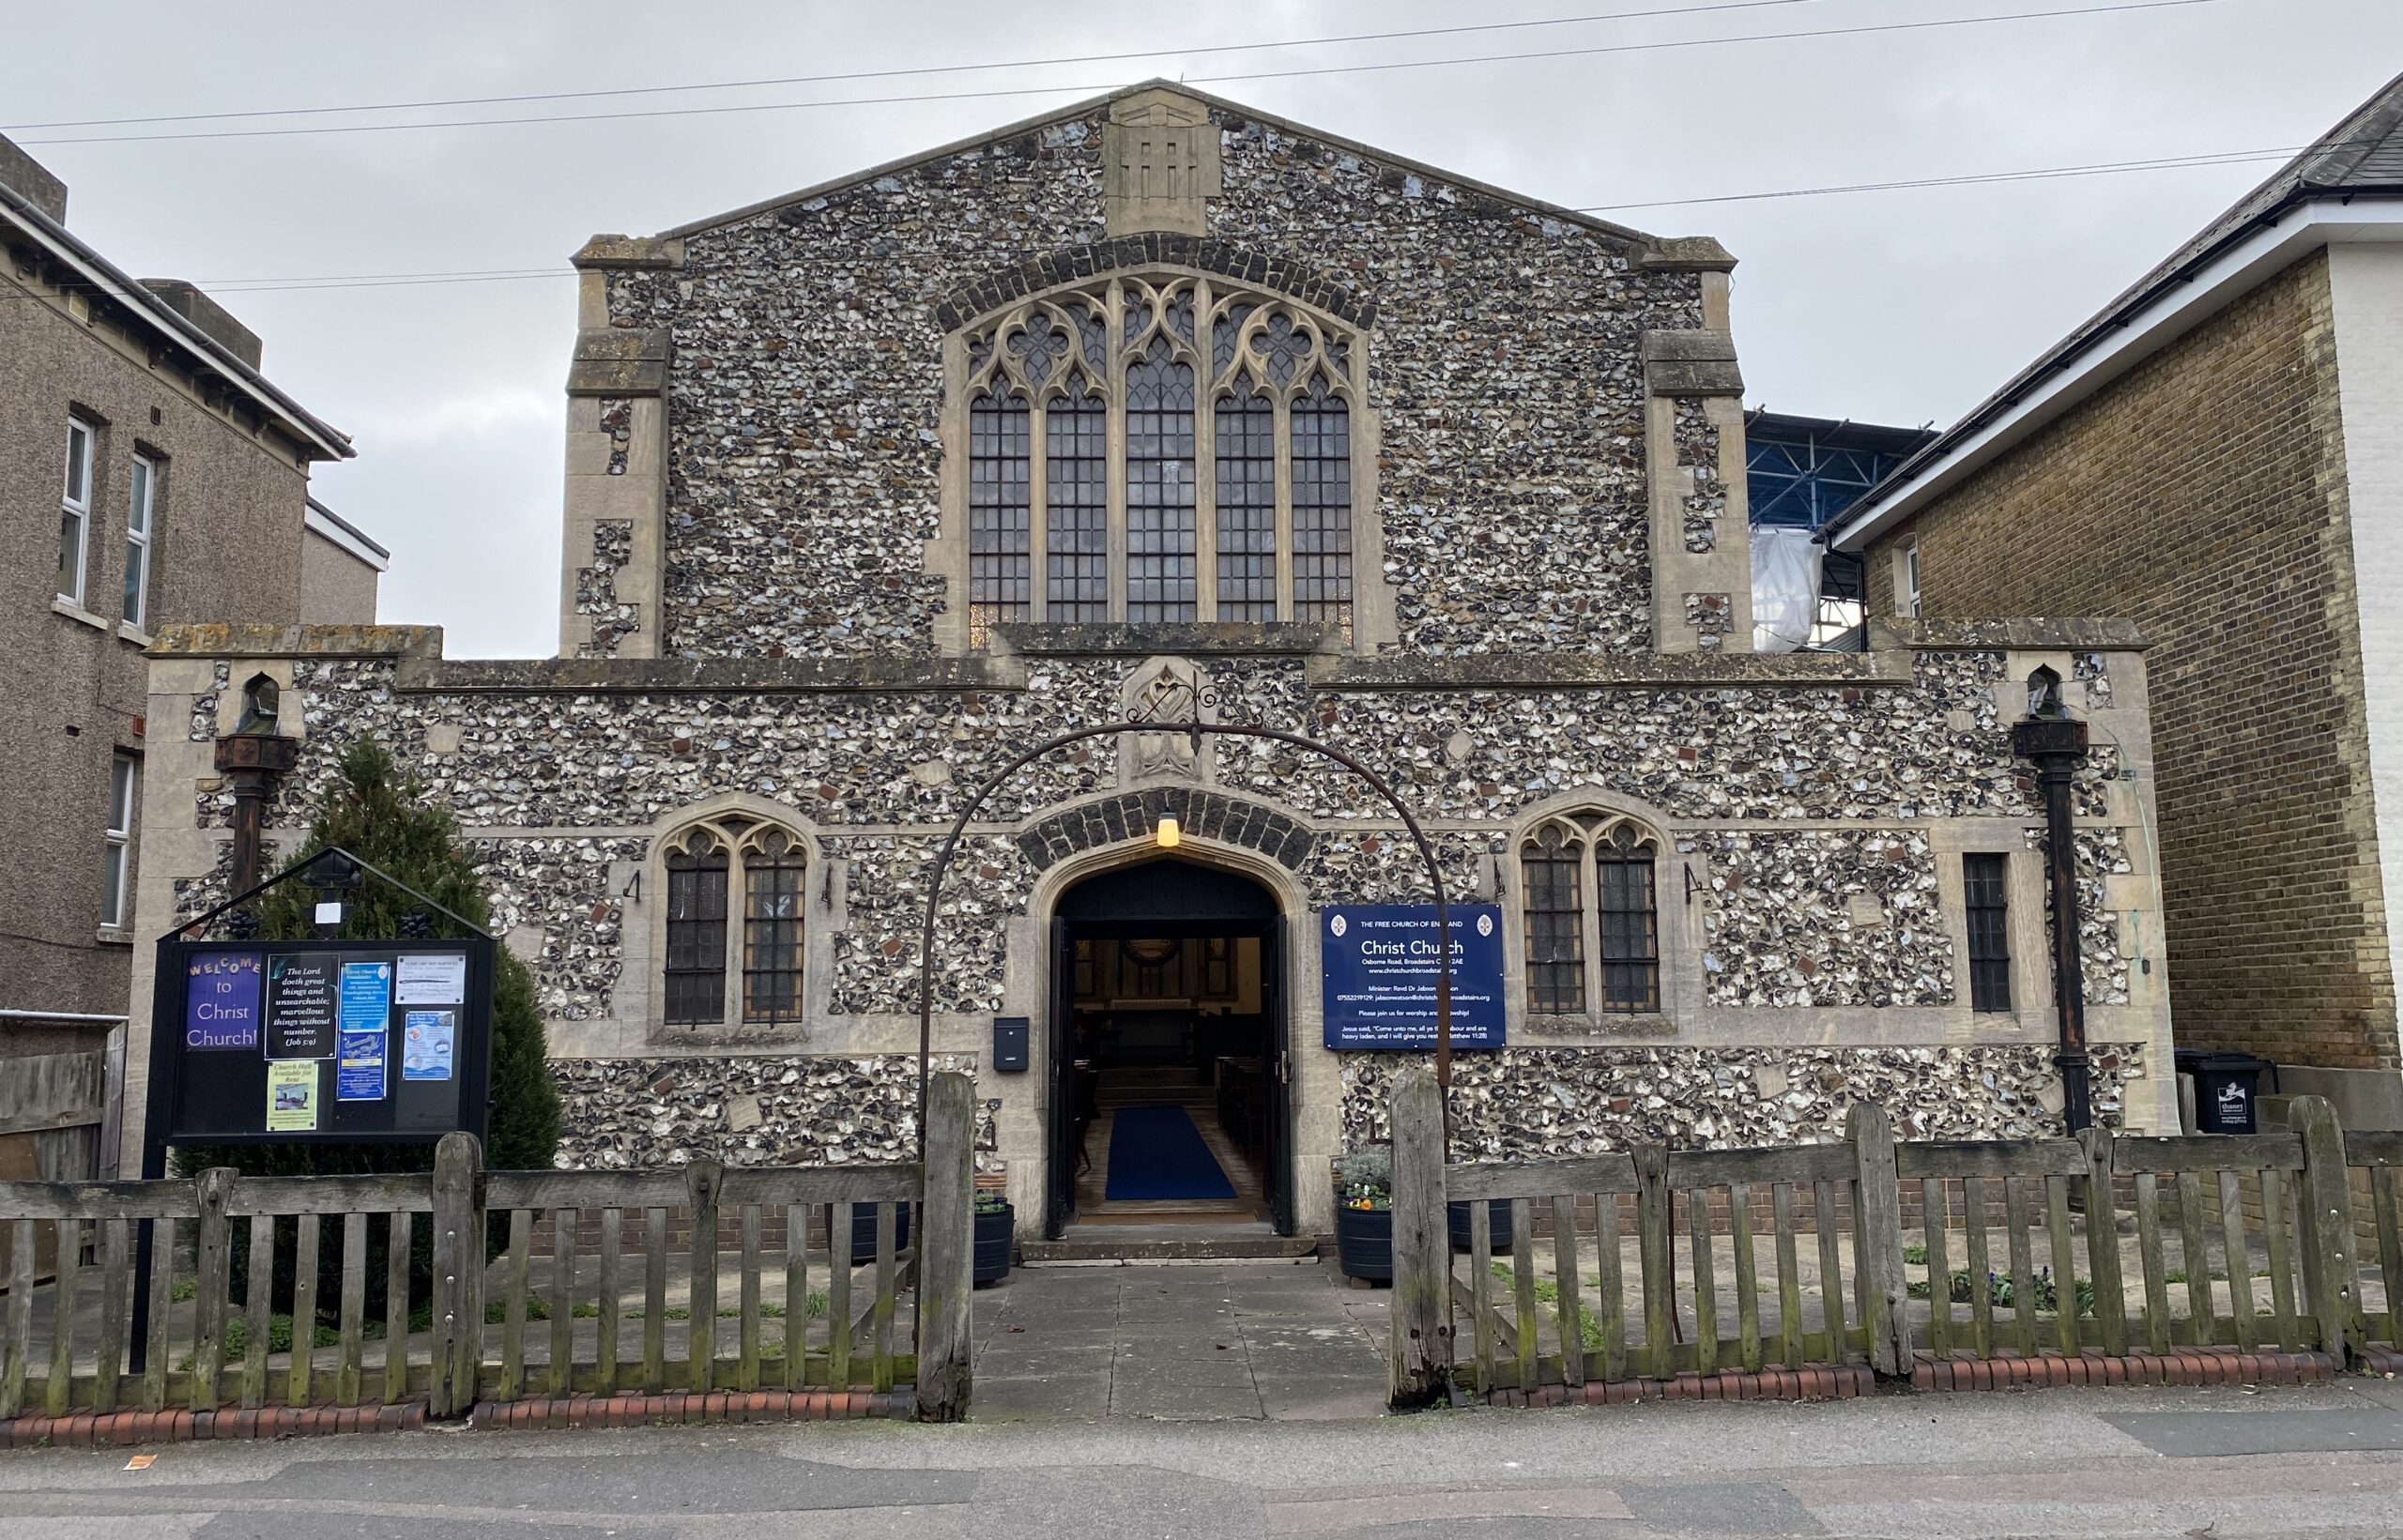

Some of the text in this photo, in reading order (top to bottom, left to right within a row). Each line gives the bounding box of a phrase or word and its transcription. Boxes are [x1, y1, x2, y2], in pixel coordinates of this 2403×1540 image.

[1361, 939, 1463, 955] Christ Chuch
[190, 958, 261, 976] WELCOME
[216, 982, 232, 993] to
[304, 978, 325, 986] great
[282, 988, 307, 996] things
[197, 1003, 249, 1020] Christ
[274, 1018, 298, 1027] things
[187, 1029, 257, 1046] Church!
